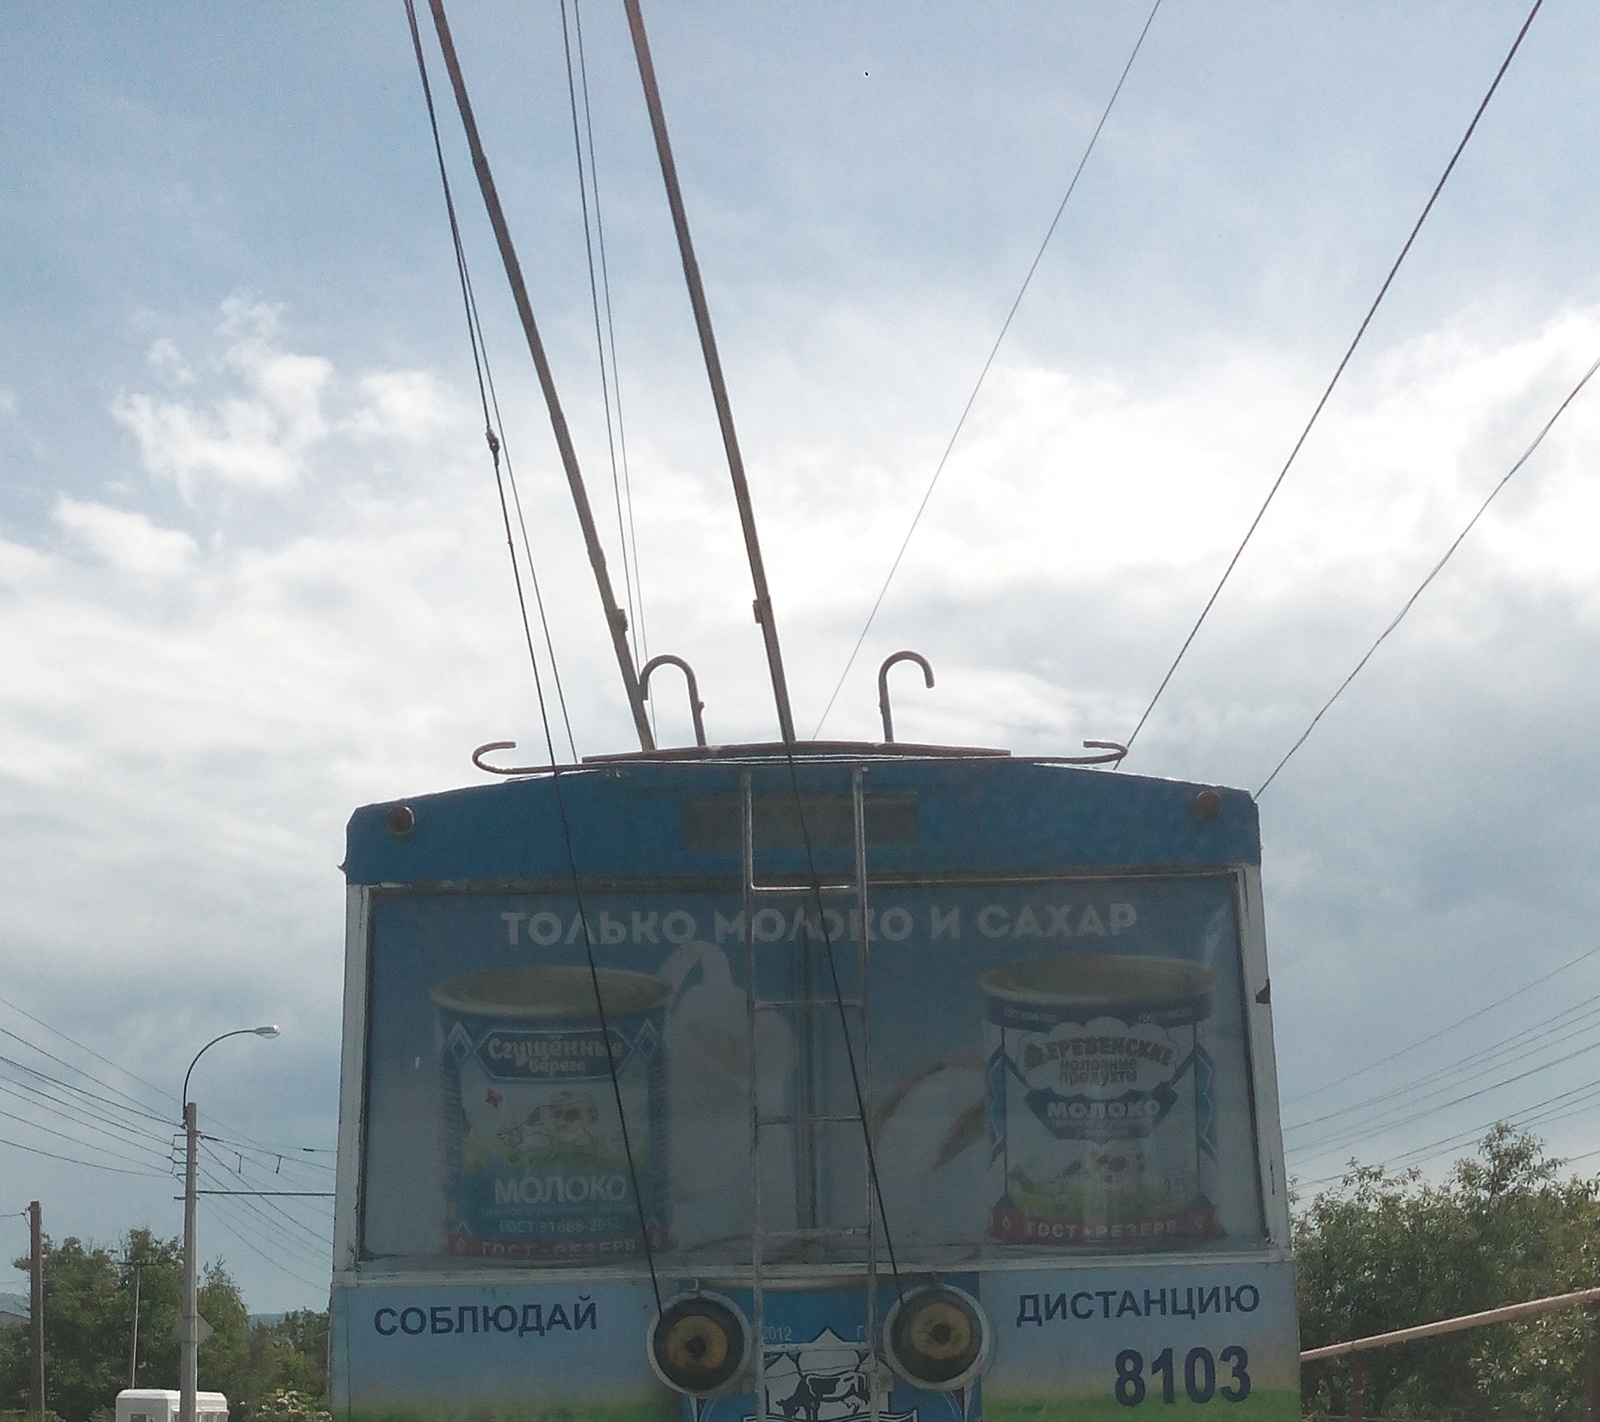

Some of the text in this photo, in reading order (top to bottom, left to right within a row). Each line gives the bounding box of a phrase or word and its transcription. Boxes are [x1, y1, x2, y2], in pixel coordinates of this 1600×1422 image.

[501, 902, 1138, 946] ТОЛЬКО МОЛОКО И САХАР
[1047, 1099, 1161, 1118] МОЛОКО
[494, 1174, 628, 1205] МОЛОКО
[1025, 1219, 1178, 1240] ГОСТ РЕЗЕРВ
[373, 1294, 598, 1337] СОБЛЮДАЙ
[1015, 1283, 1261, 1327] ДИСТАНЦИЮ
[1114, 1345, 1252, 1406] 8103
